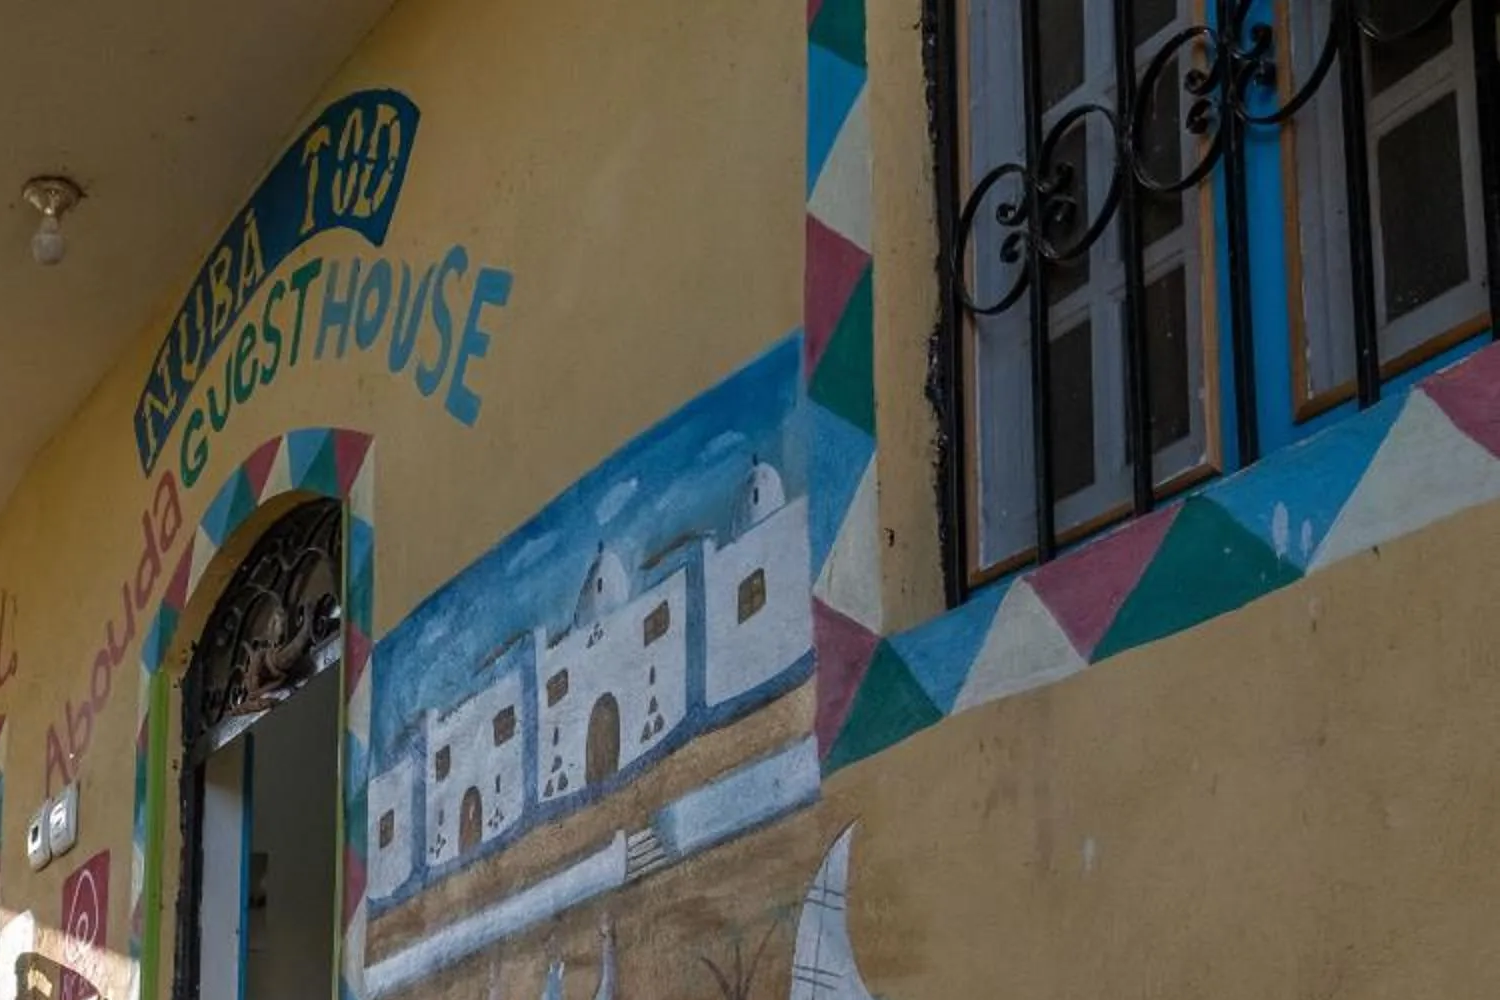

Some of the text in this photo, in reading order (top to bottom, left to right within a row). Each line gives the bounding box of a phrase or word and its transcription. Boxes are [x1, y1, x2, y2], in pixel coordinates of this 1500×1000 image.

[45, 469, 183, 798] Abouda
[314, 244, 514, 429] HOUSE
[143, 207, 266, 470] NUBA
